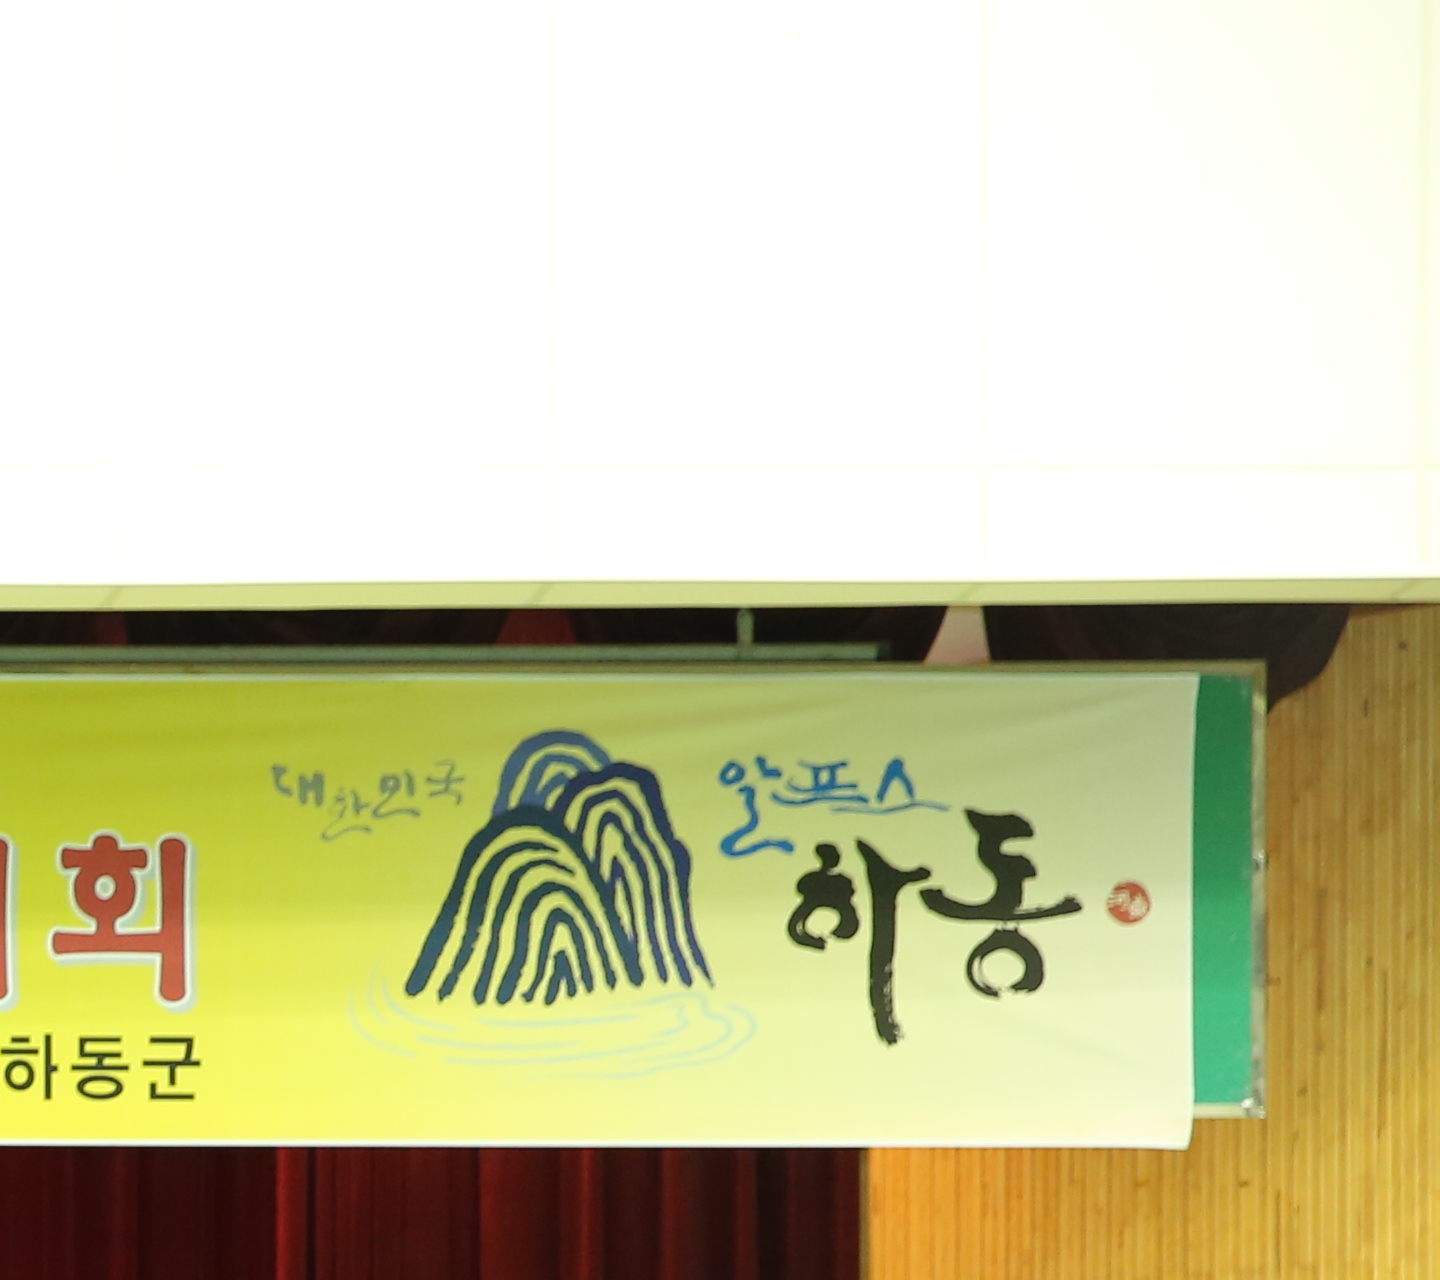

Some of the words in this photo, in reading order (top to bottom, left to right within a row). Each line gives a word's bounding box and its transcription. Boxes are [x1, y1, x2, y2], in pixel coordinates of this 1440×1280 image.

[271, 759, 466, 841] 대한민국
[719, 756, 950, 858] 알프스
[787, 807, 1083, 1047] 하동
[0, 1033, 203, 1103] 하동군
